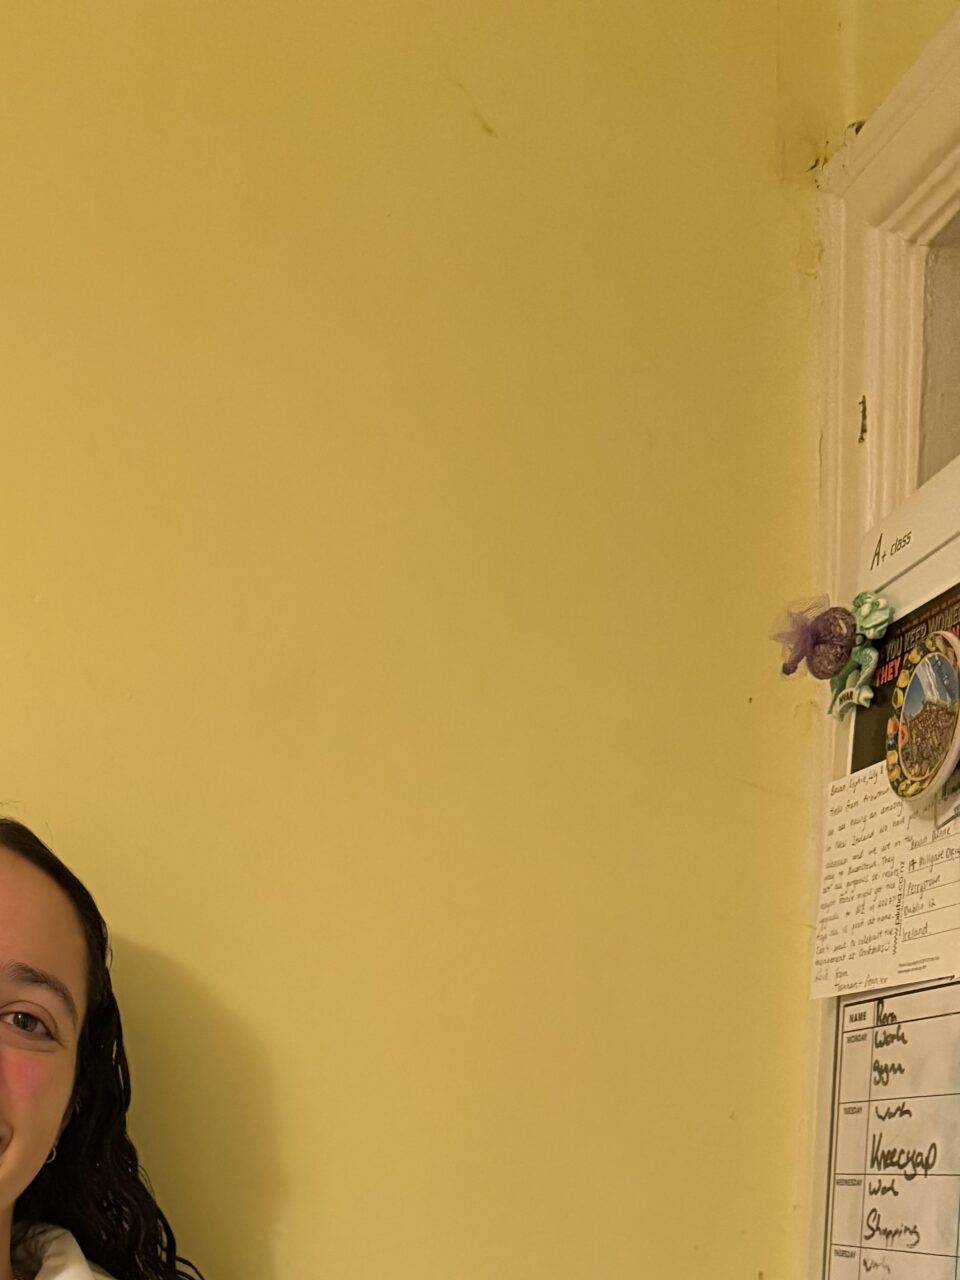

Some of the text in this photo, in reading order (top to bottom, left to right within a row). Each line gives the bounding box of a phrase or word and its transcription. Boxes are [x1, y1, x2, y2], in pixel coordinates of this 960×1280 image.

[890, 531, 912, 556] class
[886, 635, 903, 662] YOU
[875, 657, 901, 688] THEY
[849, 1011, 867, 1023] NAME
[864, 1207, 920, 1249] Shopping
